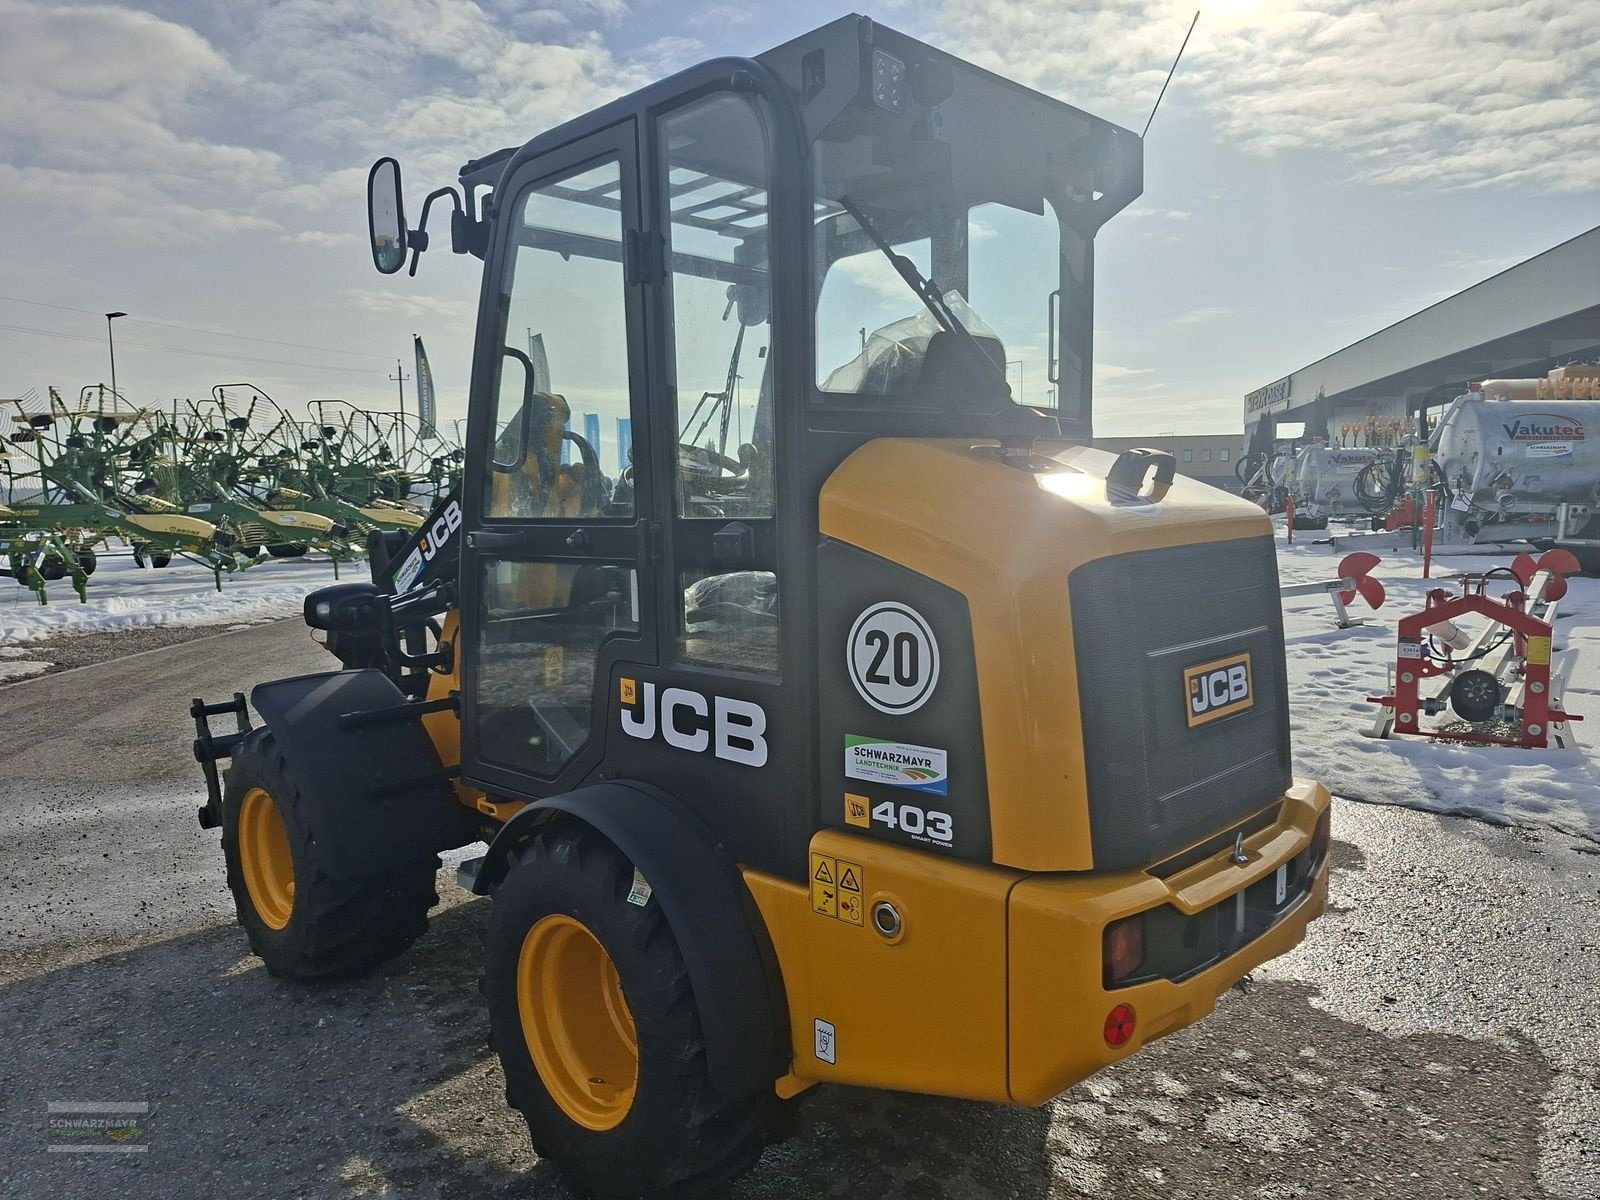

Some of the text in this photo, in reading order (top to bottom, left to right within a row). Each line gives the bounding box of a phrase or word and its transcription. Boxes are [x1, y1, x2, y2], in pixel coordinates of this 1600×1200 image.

[1502, 420, 1585, 440] Vakutec
[423, 500, 463, 562] JCB
[865, 629, 919, 687] 20
[1192, 665, 1247, 712] JCB
[620, 682, 768, 768] JCB
[854, 746, 932, 768] SCHWARZMAYR
[855, 758, 900, 772] LANDTECHNIK
[872, 801, 953, 841] 403
[911, 834, 953, 848] SMART POWER
